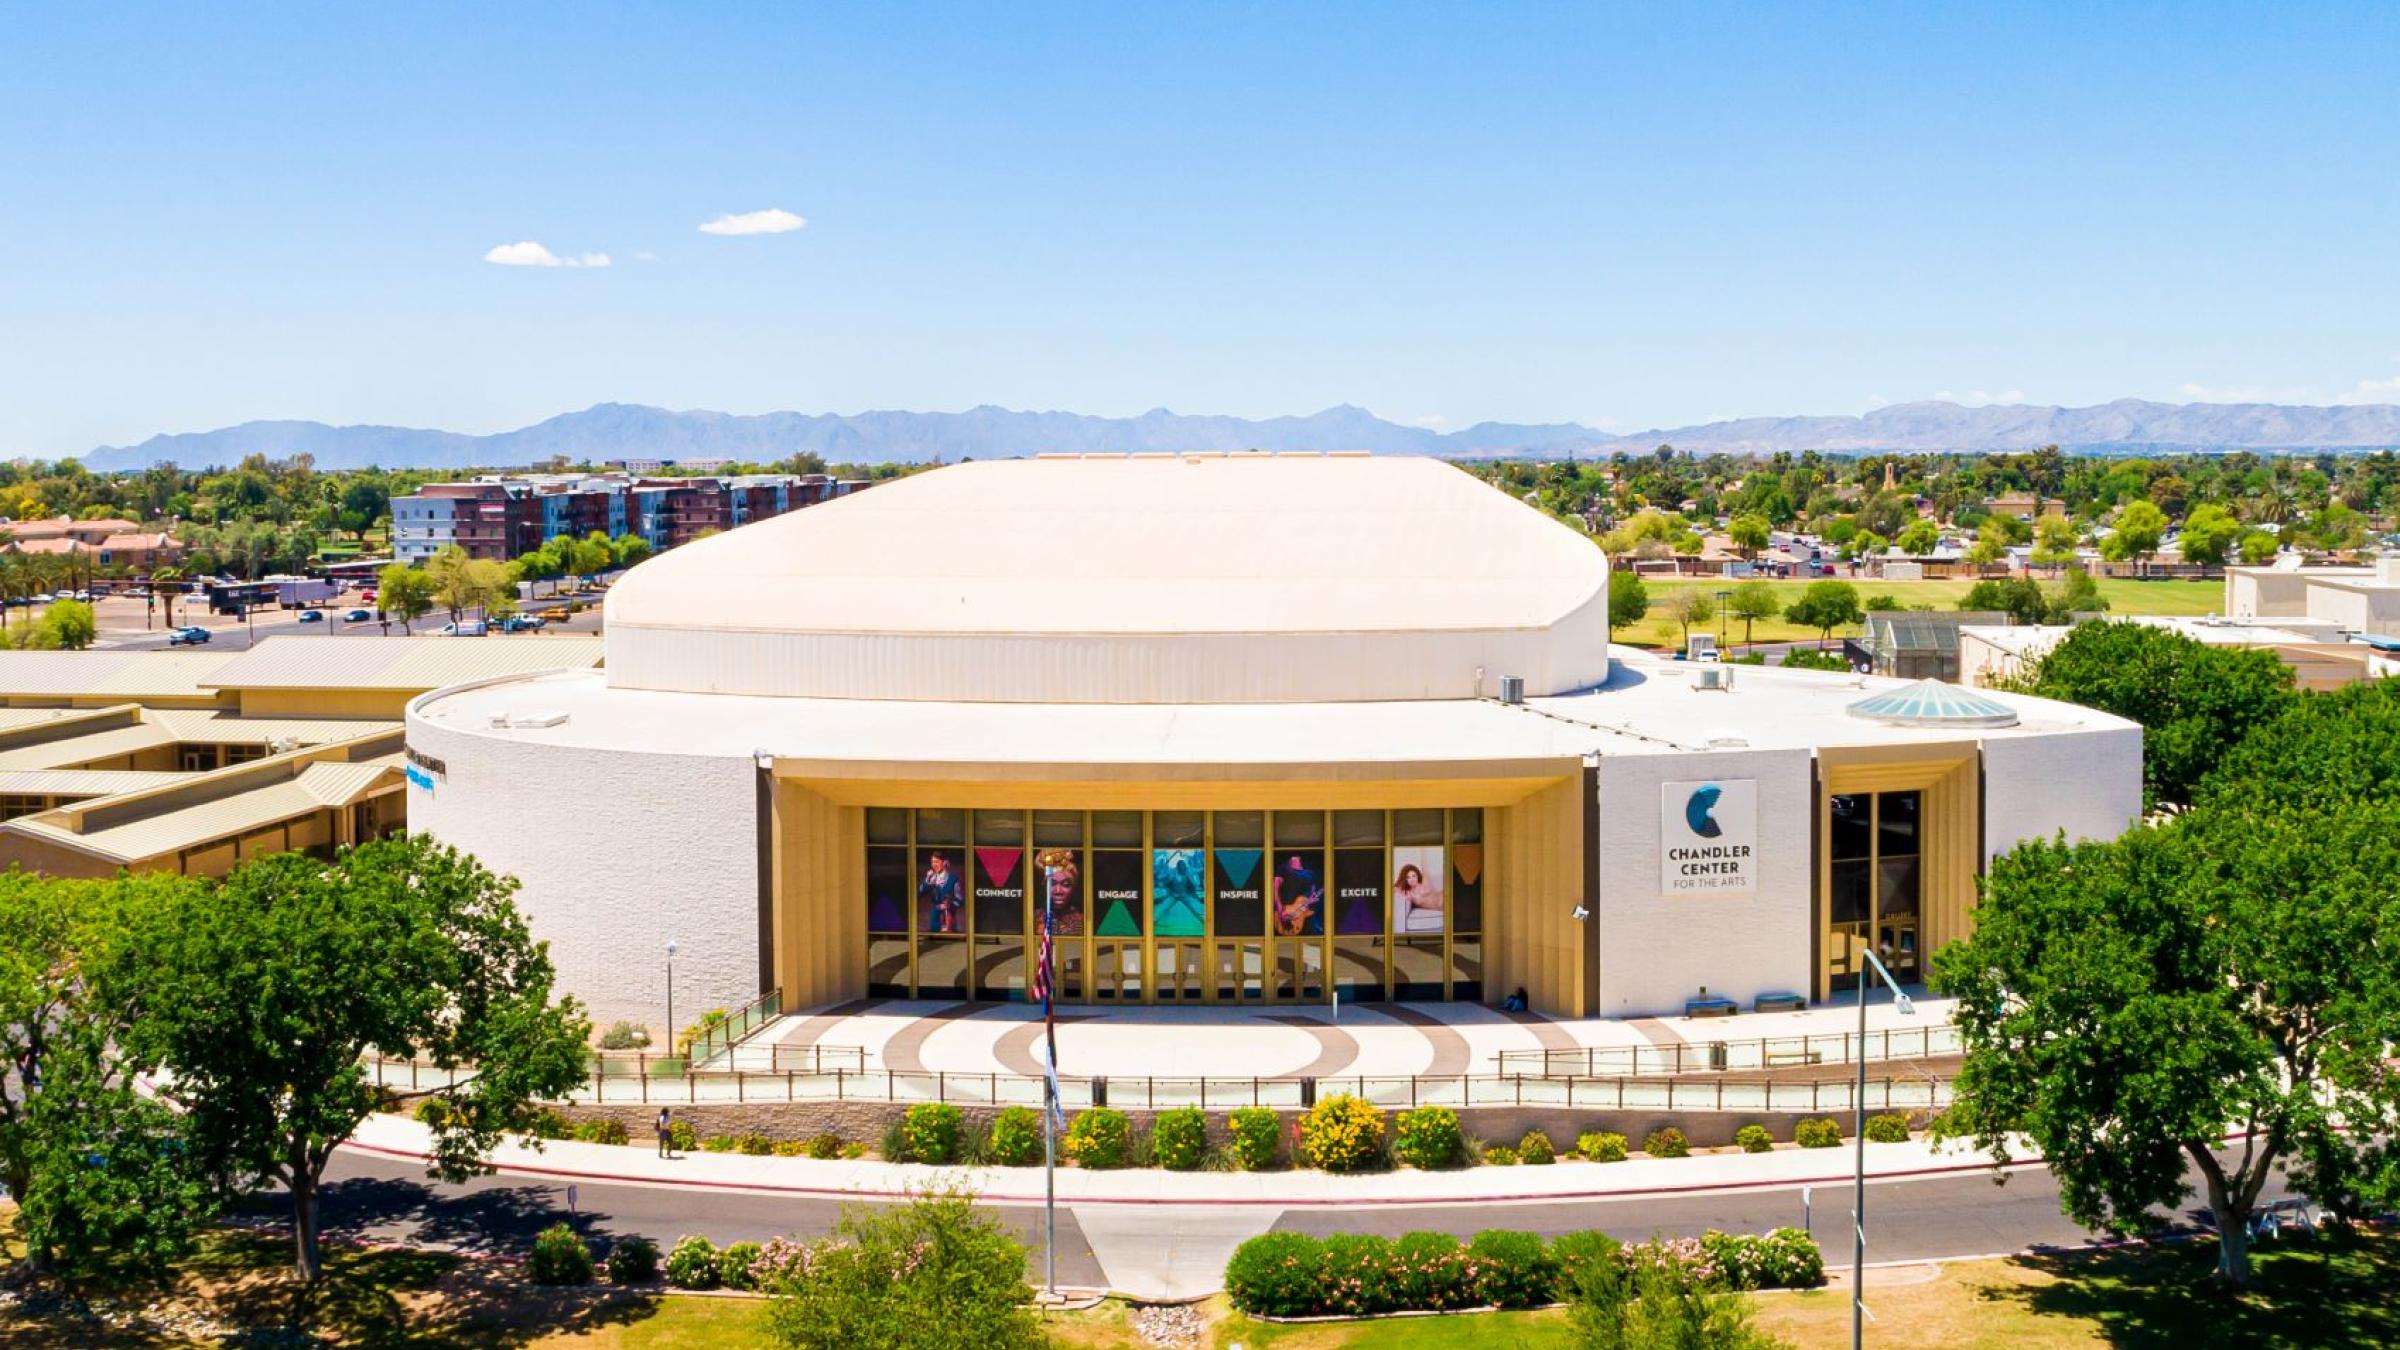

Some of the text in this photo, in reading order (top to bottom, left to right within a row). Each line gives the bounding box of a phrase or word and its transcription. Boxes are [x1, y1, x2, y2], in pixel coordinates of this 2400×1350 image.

[1669, 845, 1751, 860] CHANDLER
[1681, 862, 1739, 876] CENTER
[1673, 876, 1746, 888] FOR THE ARTS
[976, 888, 1022, 898] CONNECT
[1098, 890, 1138, 899] ENGAGE
[1220, 890, 1259, 899] INSPIRE
[1340, 888, 1377, 897] EXCITE
